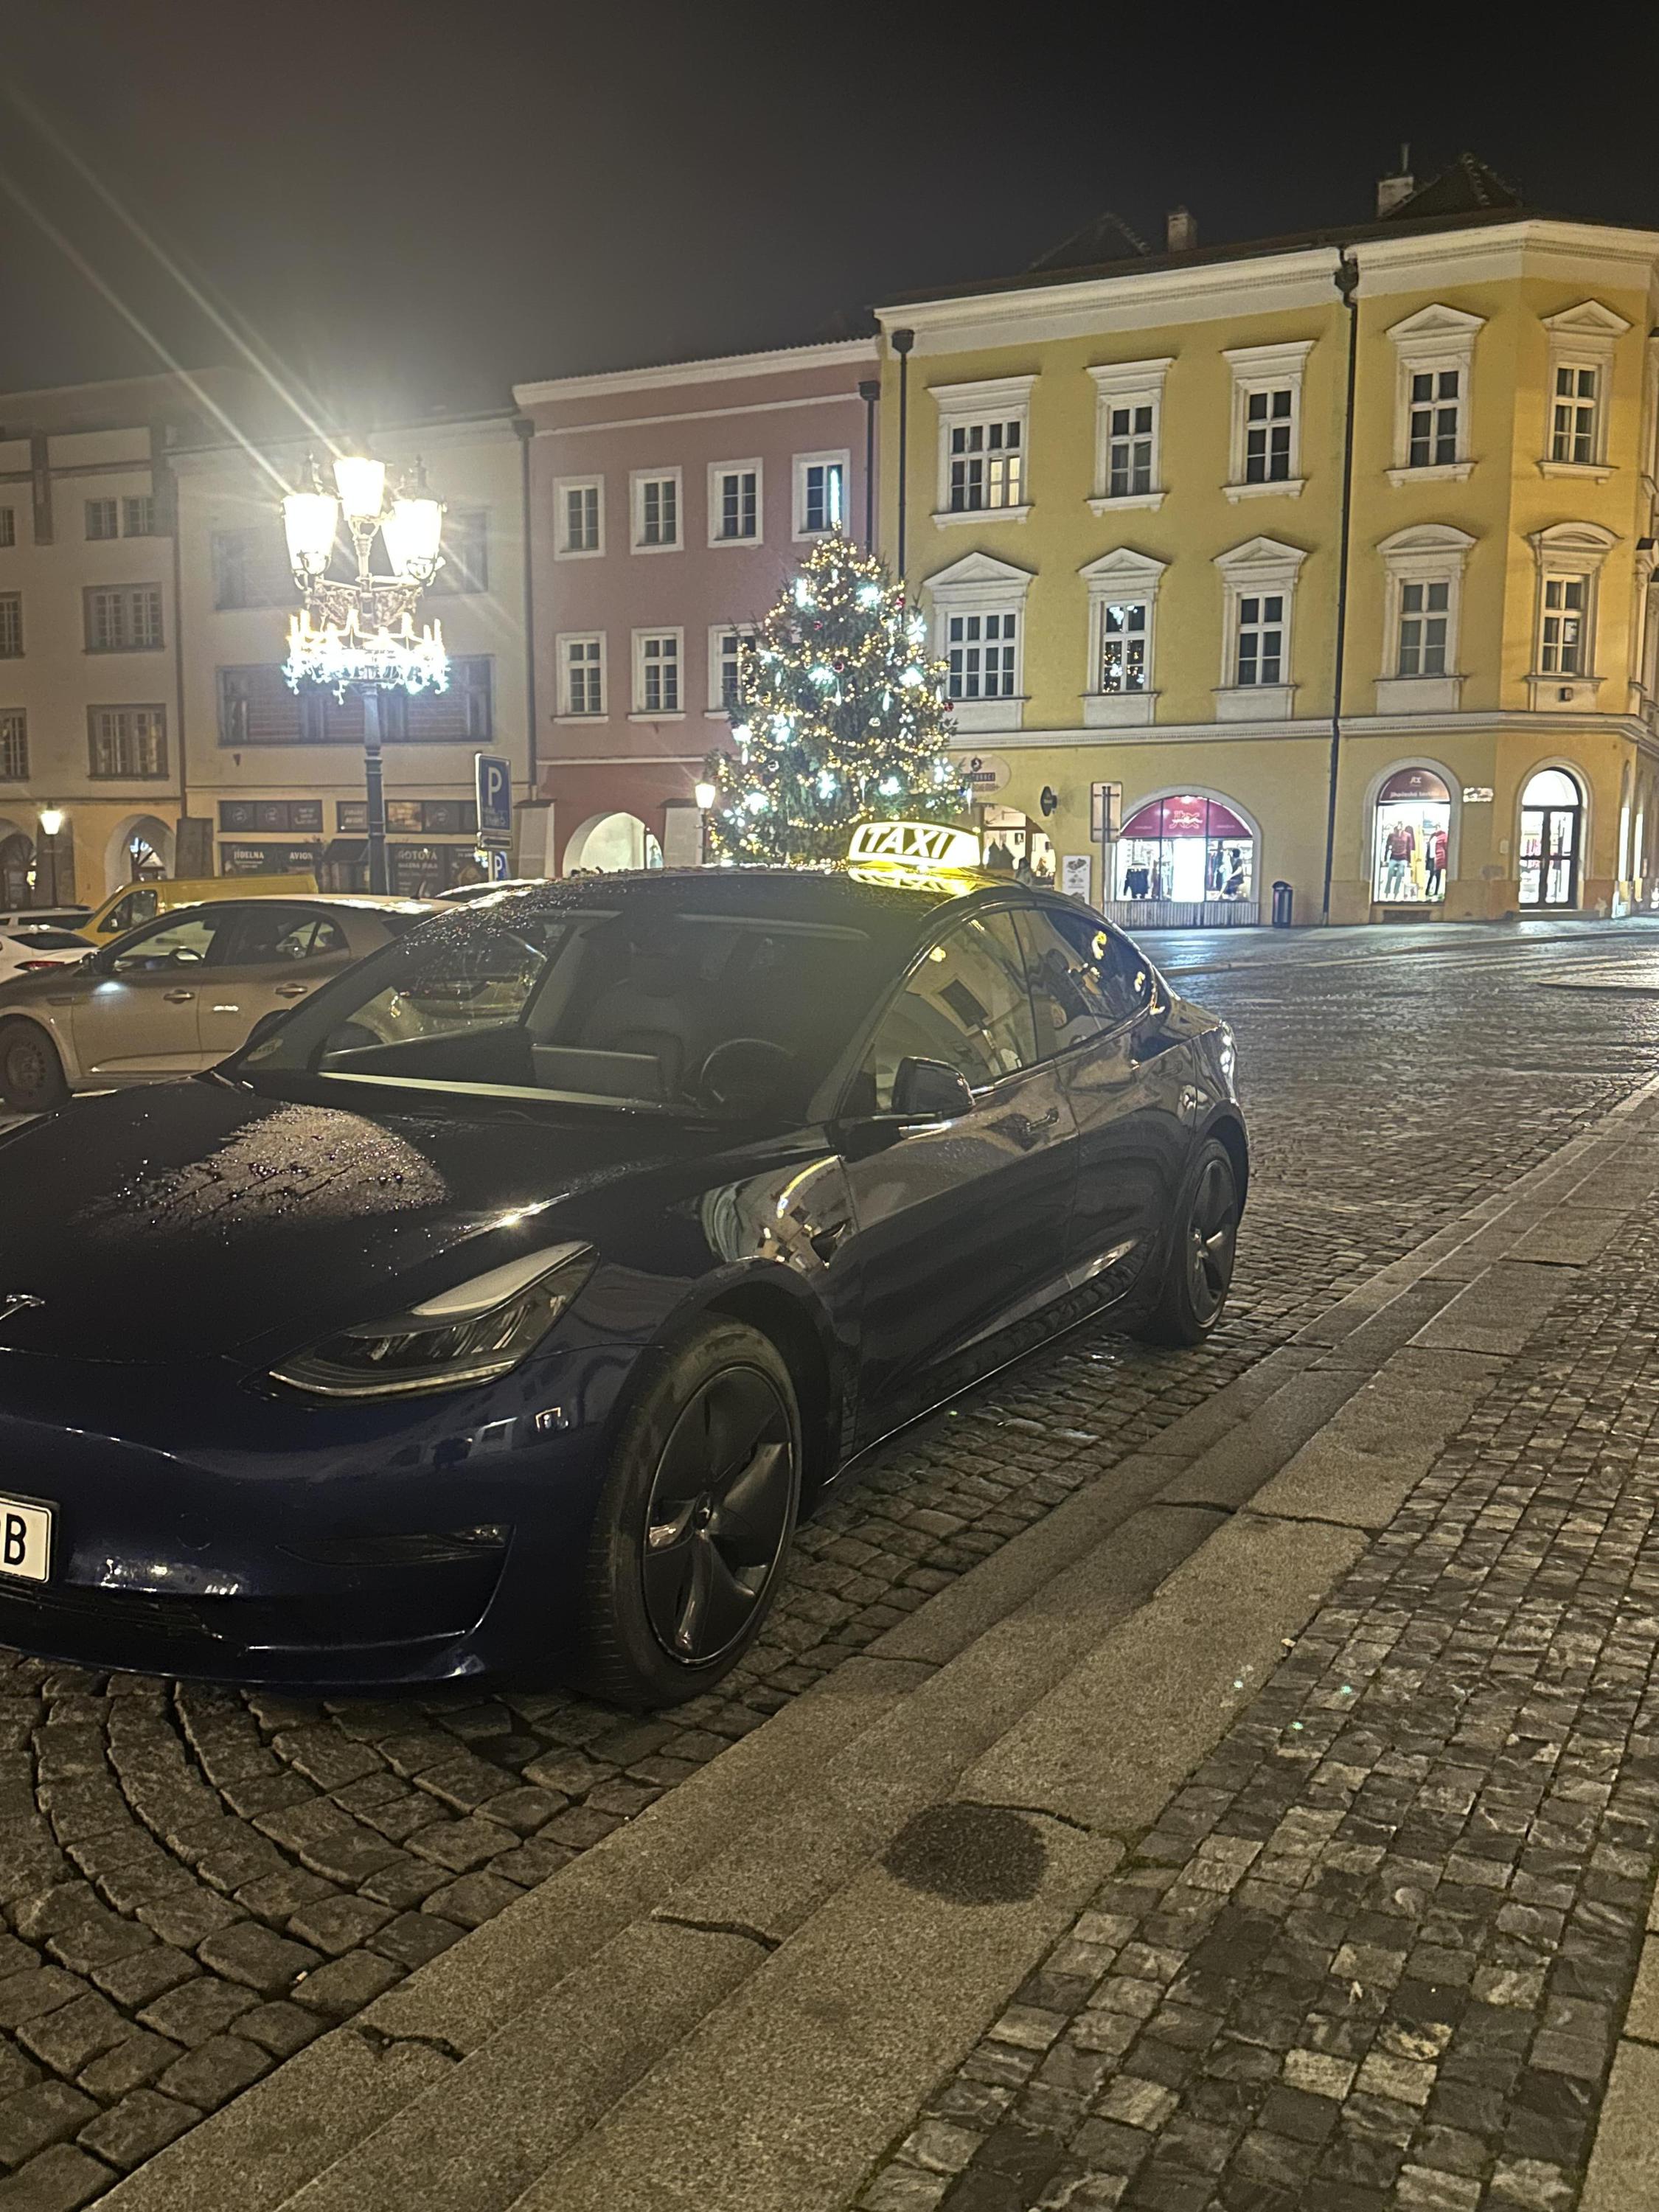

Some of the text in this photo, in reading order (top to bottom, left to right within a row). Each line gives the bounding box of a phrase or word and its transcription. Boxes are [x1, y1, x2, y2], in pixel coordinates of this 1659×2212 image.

[487, 767, 502, 806] P
[234, 849, 313, 860] JÍDELNA AVION
[865, 827, 949, 859] TAXI
[495, 855, 503, 882] P
[4, 1513, 27, 1565] B
